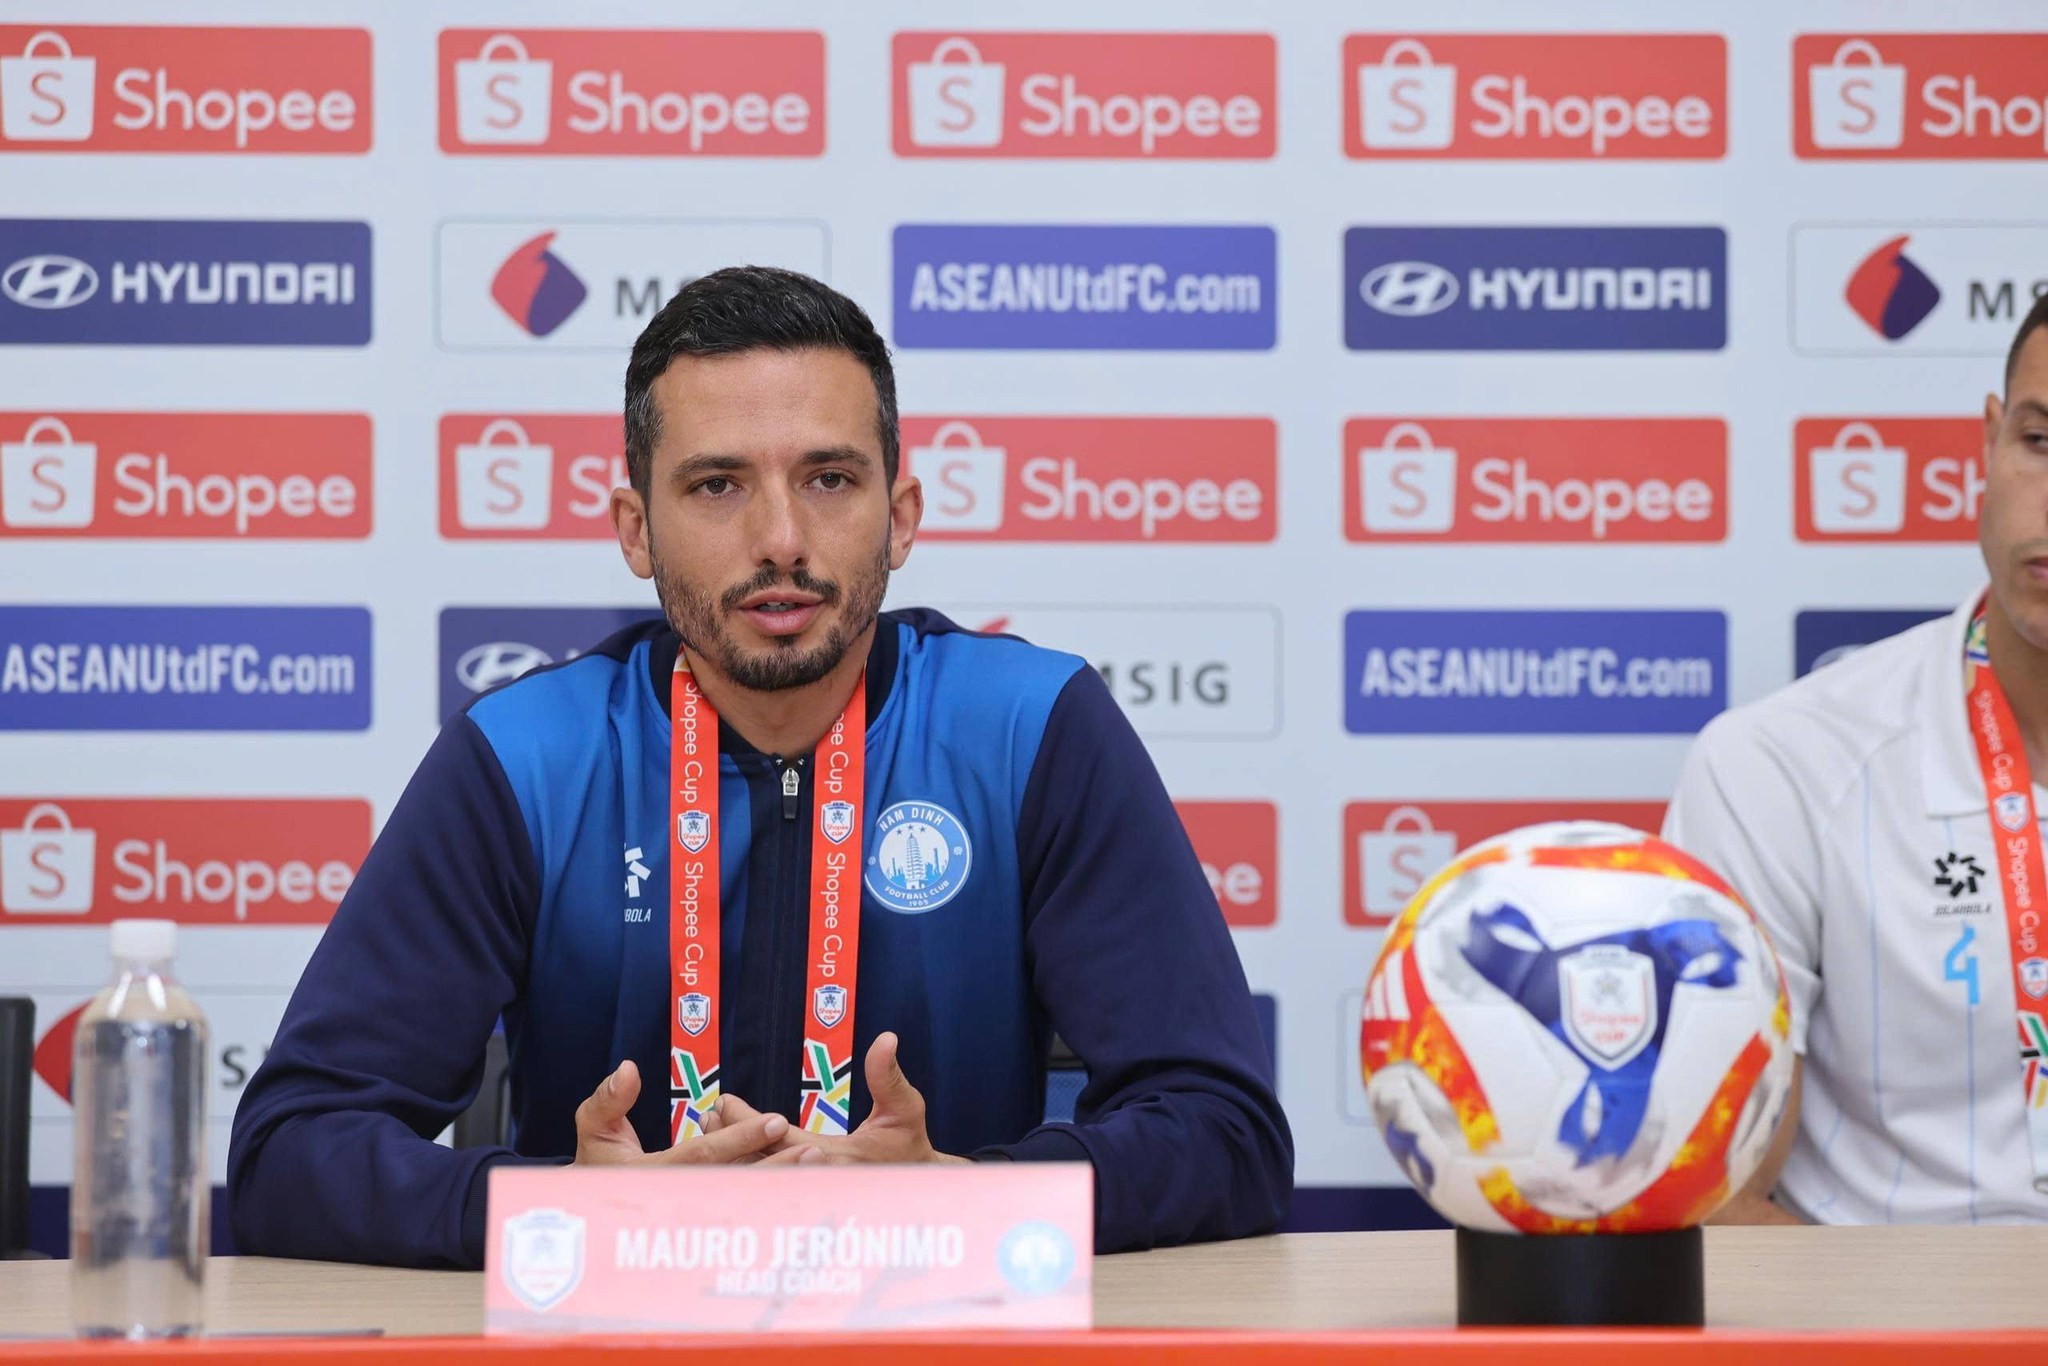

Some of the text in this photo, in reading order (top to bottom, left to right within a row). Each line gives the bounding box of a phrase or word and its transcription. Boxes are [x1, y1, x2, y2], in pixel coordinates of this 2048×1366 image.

[29, 67, 357, 149] S Shopee
[486, 70, 811, 152] S Shopee
[937, 72, 1262, 154] S Shopee
[1389, 74, 1712, 155] S Shopee
[1839, 74, 2048, 153] S Sho
[111, 262, 356, 305] HYUNDAI
[910, 262, 1261, 313] ASEANUtdFC.com
[1468, 267, 1712, 311] HYUNDAI
[30, 452, 357, 535] S Shopee
[485, 457, 524, 515] S
[938, 456, 1263, 538] S Shopee
[1389, 457, 1714, 539] S Shopee
[1840, 460, 1878, 519] S
[1, 643, 356, 695] ASEANUtdFC.com
[1360, 647, 1712, 698] ASEANUtdFC.com
[679, 760, 703, 804] Cup
[823, 751, 849, 794] Cup
[879, 807, 944, 832] NAM DINH
[29, 839, 352, 920] S Shopee
[820, 852, 846, 930] Shopee
[884, 880, 950, 900] FOOTBALL CLUB
[2005, 836, 2032, 909] Shopee
[624, 907, 652, 923] BOLA
[680, 861, 704, 938] Shopee
[817, 934, 843, 977] Cup
[2015, 910, 2041, 954] Cup
[679, 943, 704, 986] Cup
[614, 1217, 966, 1270] MAURO JERÓNIMO
[715, 1270, 863, 1297] HEAD COACH
